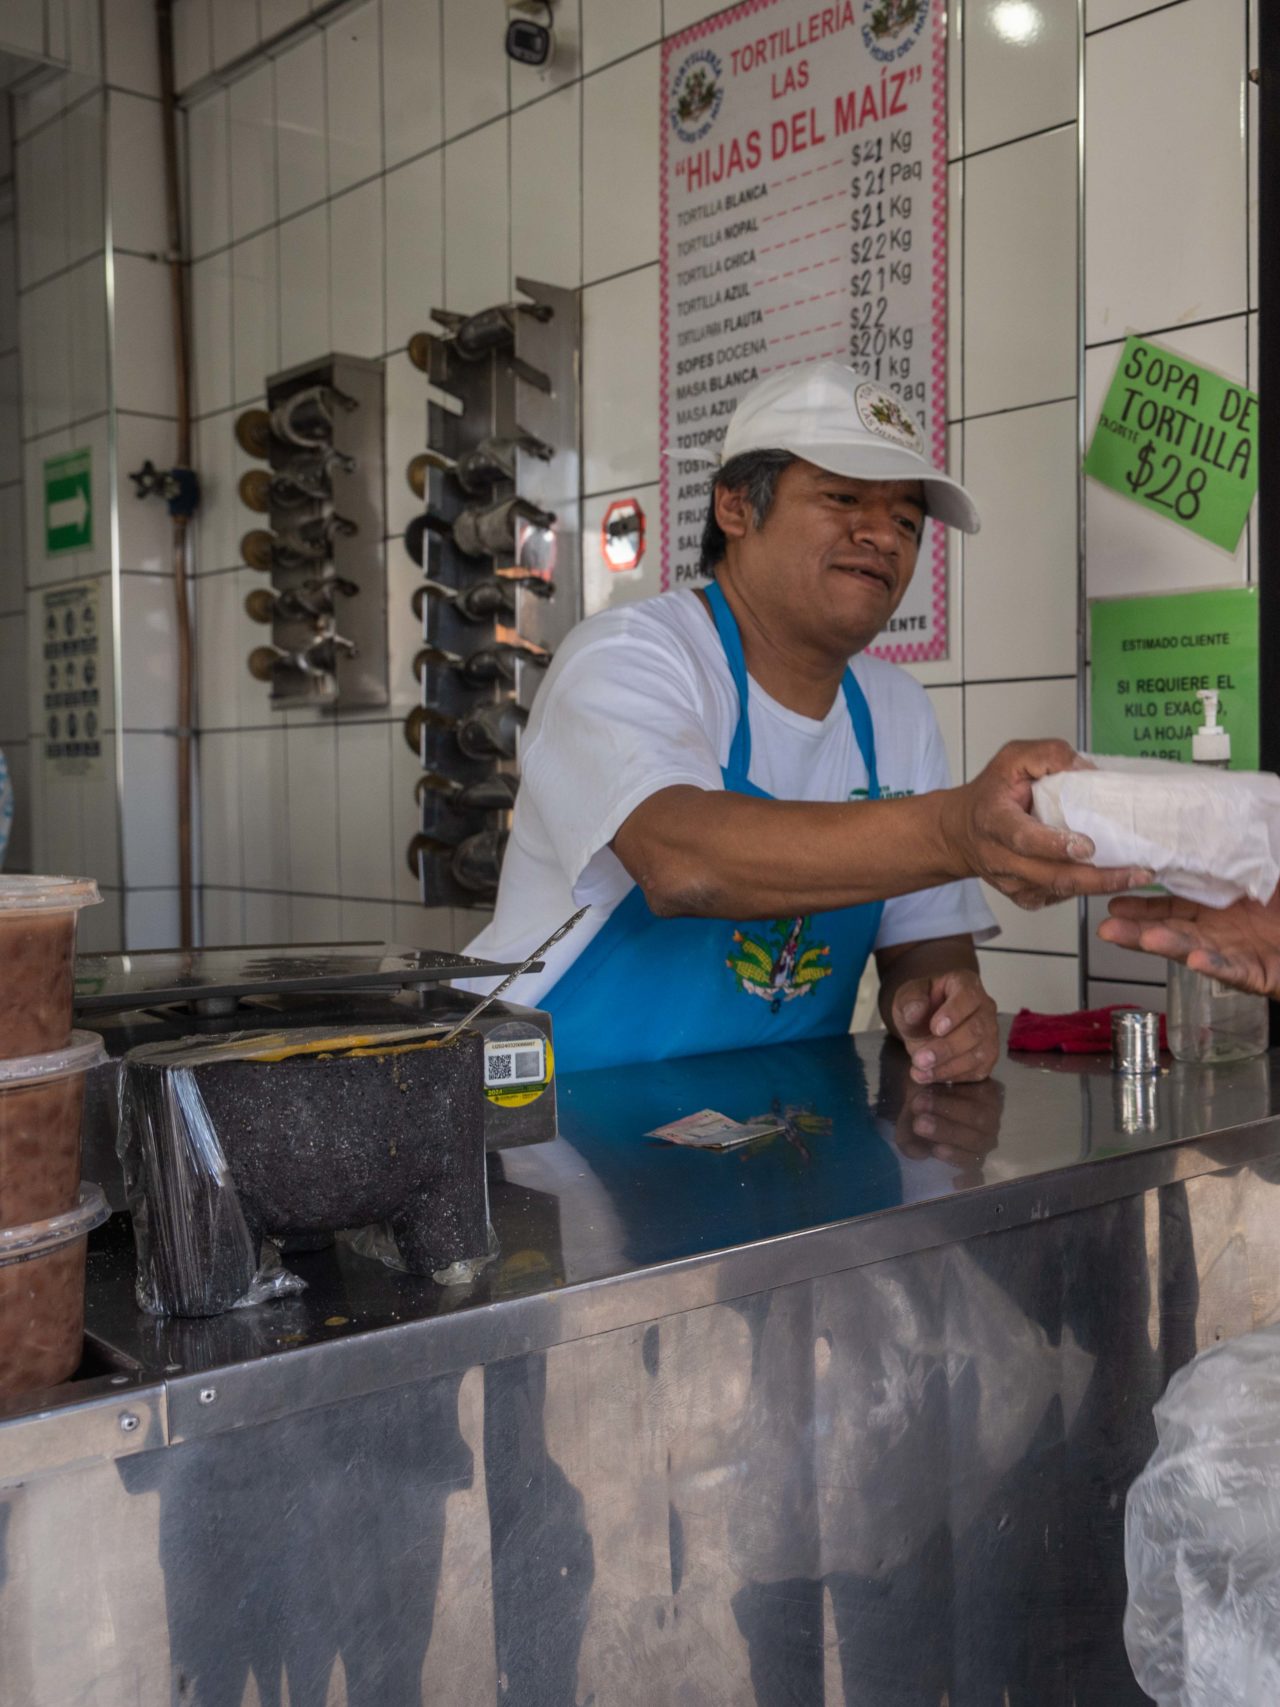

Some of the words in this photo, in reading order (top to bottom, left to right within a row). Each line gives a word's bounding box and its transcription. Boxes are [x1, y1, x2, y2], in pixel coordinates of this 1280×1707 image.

[772, 60, 809, 99] LAS
[771, 107, 825, 161] DEL
[677, 203, 723, 227] TORTILLA
[725, 183, 768, 211] BLANCA
[890, 129, 912, 153] Kg
[677, 234, 722, 257] TORTILLA
[724, 218, 759, 241] NOPAL
[851, 167, 885, 199] $21
[890, 160, 922, 184] Paq
[677, 263, 722, 287] TORTILLA
[724, 249, 756, 271] CHICA
[851, 201, 885, 232] $21
[890, 194, 912, 219] Kg
[677, 292, 721, 317] TORTILLA
[724, 283, 750, 302] AZUL
[851, 232, 887, 265] $22
[890, 228, 912, 252] Kg
[724, 309, 763, 333] FLAUTA
[850, 267, 885, 297] $21
[890, 262, 912, 285] Kg
[677, 352, 714, 376] SOPES
[717, 338, 767, 365] DOCENA
[850, 298, 887, 330] $22
[677, 381, 707, 400] MASA
[709, 366, 759, 392] BLANCA
[850, 329, 886, 357] $20
[889, 326, 913, 350] Kg
[677, 405, 707, 424] MASA
[1124, 347, 1200, 406] SOPA
[1220, 388, 1259, 432] DE
[677, 425, 728, 449] TOTOPO
[1121, 387, 1252, 480] TORTILLA
[1125, 440, 1207, 520] $28
[1122, 636, 1178, 651] ESTIMADO
[1180, 633, 1230, 647] CLIENTE
[1117, 680, 1130, 694] SI
[1136, 675, 1209, 693] REQUIERE
[1217, 675, 1235, 690] EL
[1125, 702, 1157, 718] KILO
[1164, 700, 1227, 717] EXACO,
[1133, 727, 1151, 741] LA
[1155, 725, 1194, 740] HOJA
